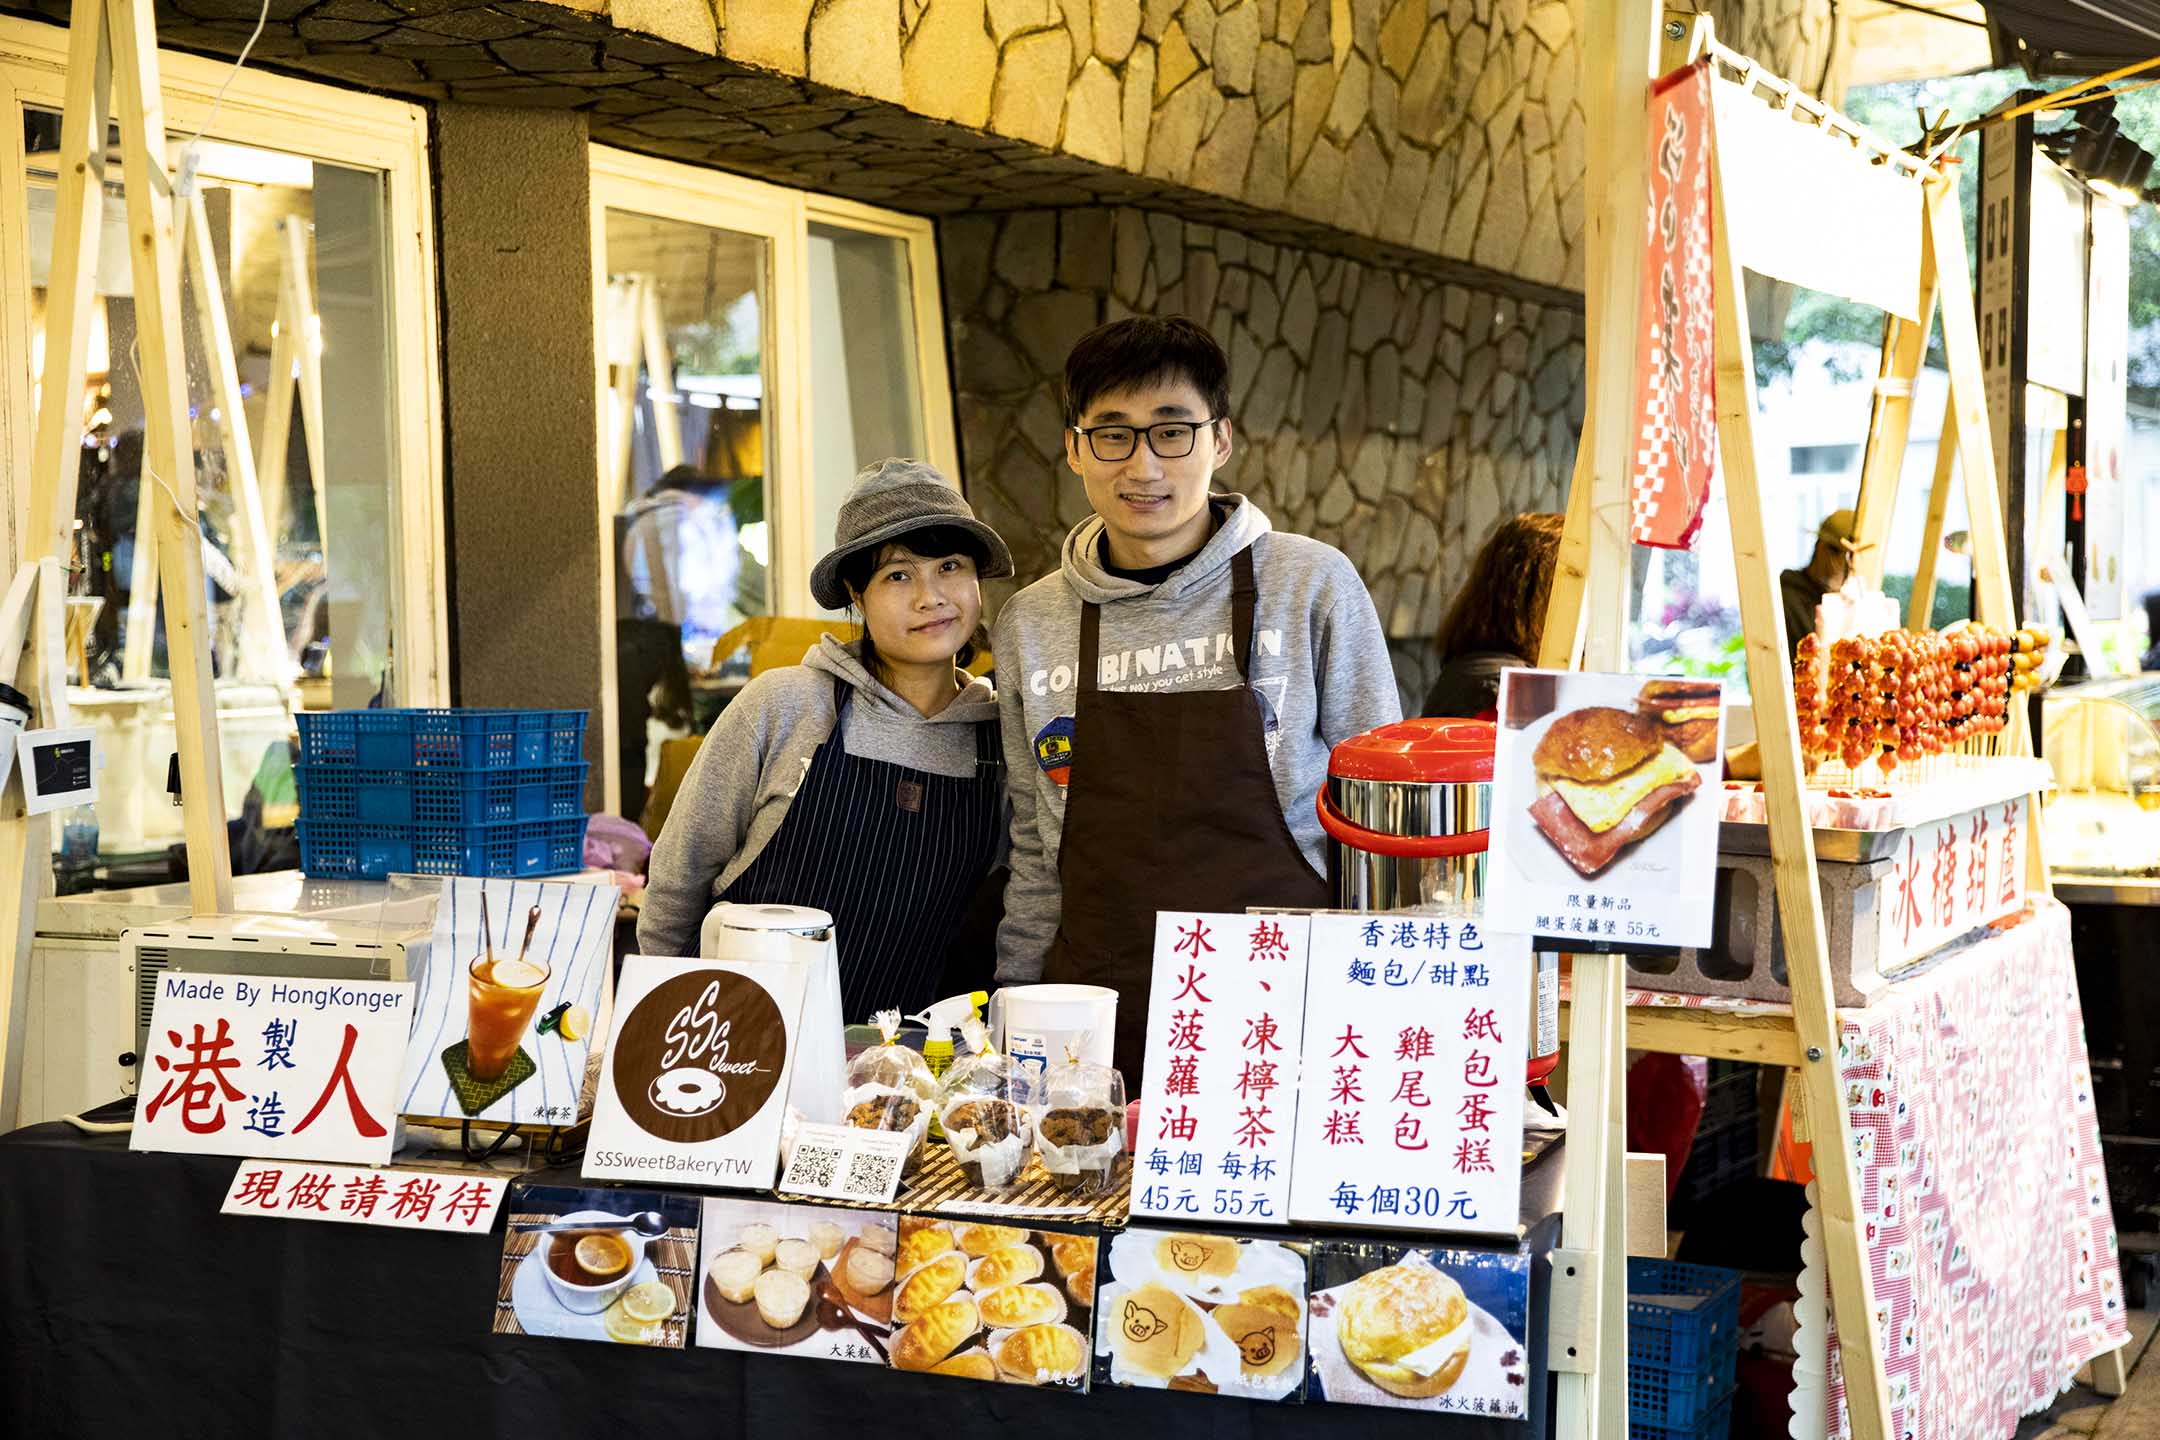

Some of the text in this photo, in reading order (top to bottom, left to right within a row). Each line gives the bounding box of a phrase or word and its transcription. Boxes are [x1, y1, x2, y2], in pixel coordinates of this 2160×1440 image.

[1030, 629, 1283, 697] COBINATIN
[1152, 676, 1172, 691] you
[1197, 663, 1224, 680] style
[1567, 894, 1632, 911] 限量新品
[1360, 919, 1484, 951] 香港特色
[1627, 921, 1660, 937] 55元
[1347, 957, 1490, 987] 麵包/甜點
[166, 979, 403, 1012] Made By HongKonger
[1158, 918, 1216, 1142] 冰火菠蘿油
[1233, 920, 1289, 1149] 熱、凍檸茶
[145, 1017, 247, 1134] 港
[291, 1023, 388, 1138] 人
[1322, 1024, 1370, 1145] 大菜糕
[1390, 1026, 1435, 1151] 雞尾包
[1452, 1007, 1502, 1174] 紙包蛋糕
[594, 1151, 753, 1175] SSSweetBakeryTW
[1144, 1147, 1276, 1181] 每個 每杯
[233, 1169, 493, 1227] 現做請稍待
[1140, 1185, 1273, 1217] 45元 55元
[1328, 1181, 1478, 1220] 每個30元
[830, 1343, 872, 1359] 大菜糕
[1439, 1394, 1519, 1415] 冰火菠蘿油
